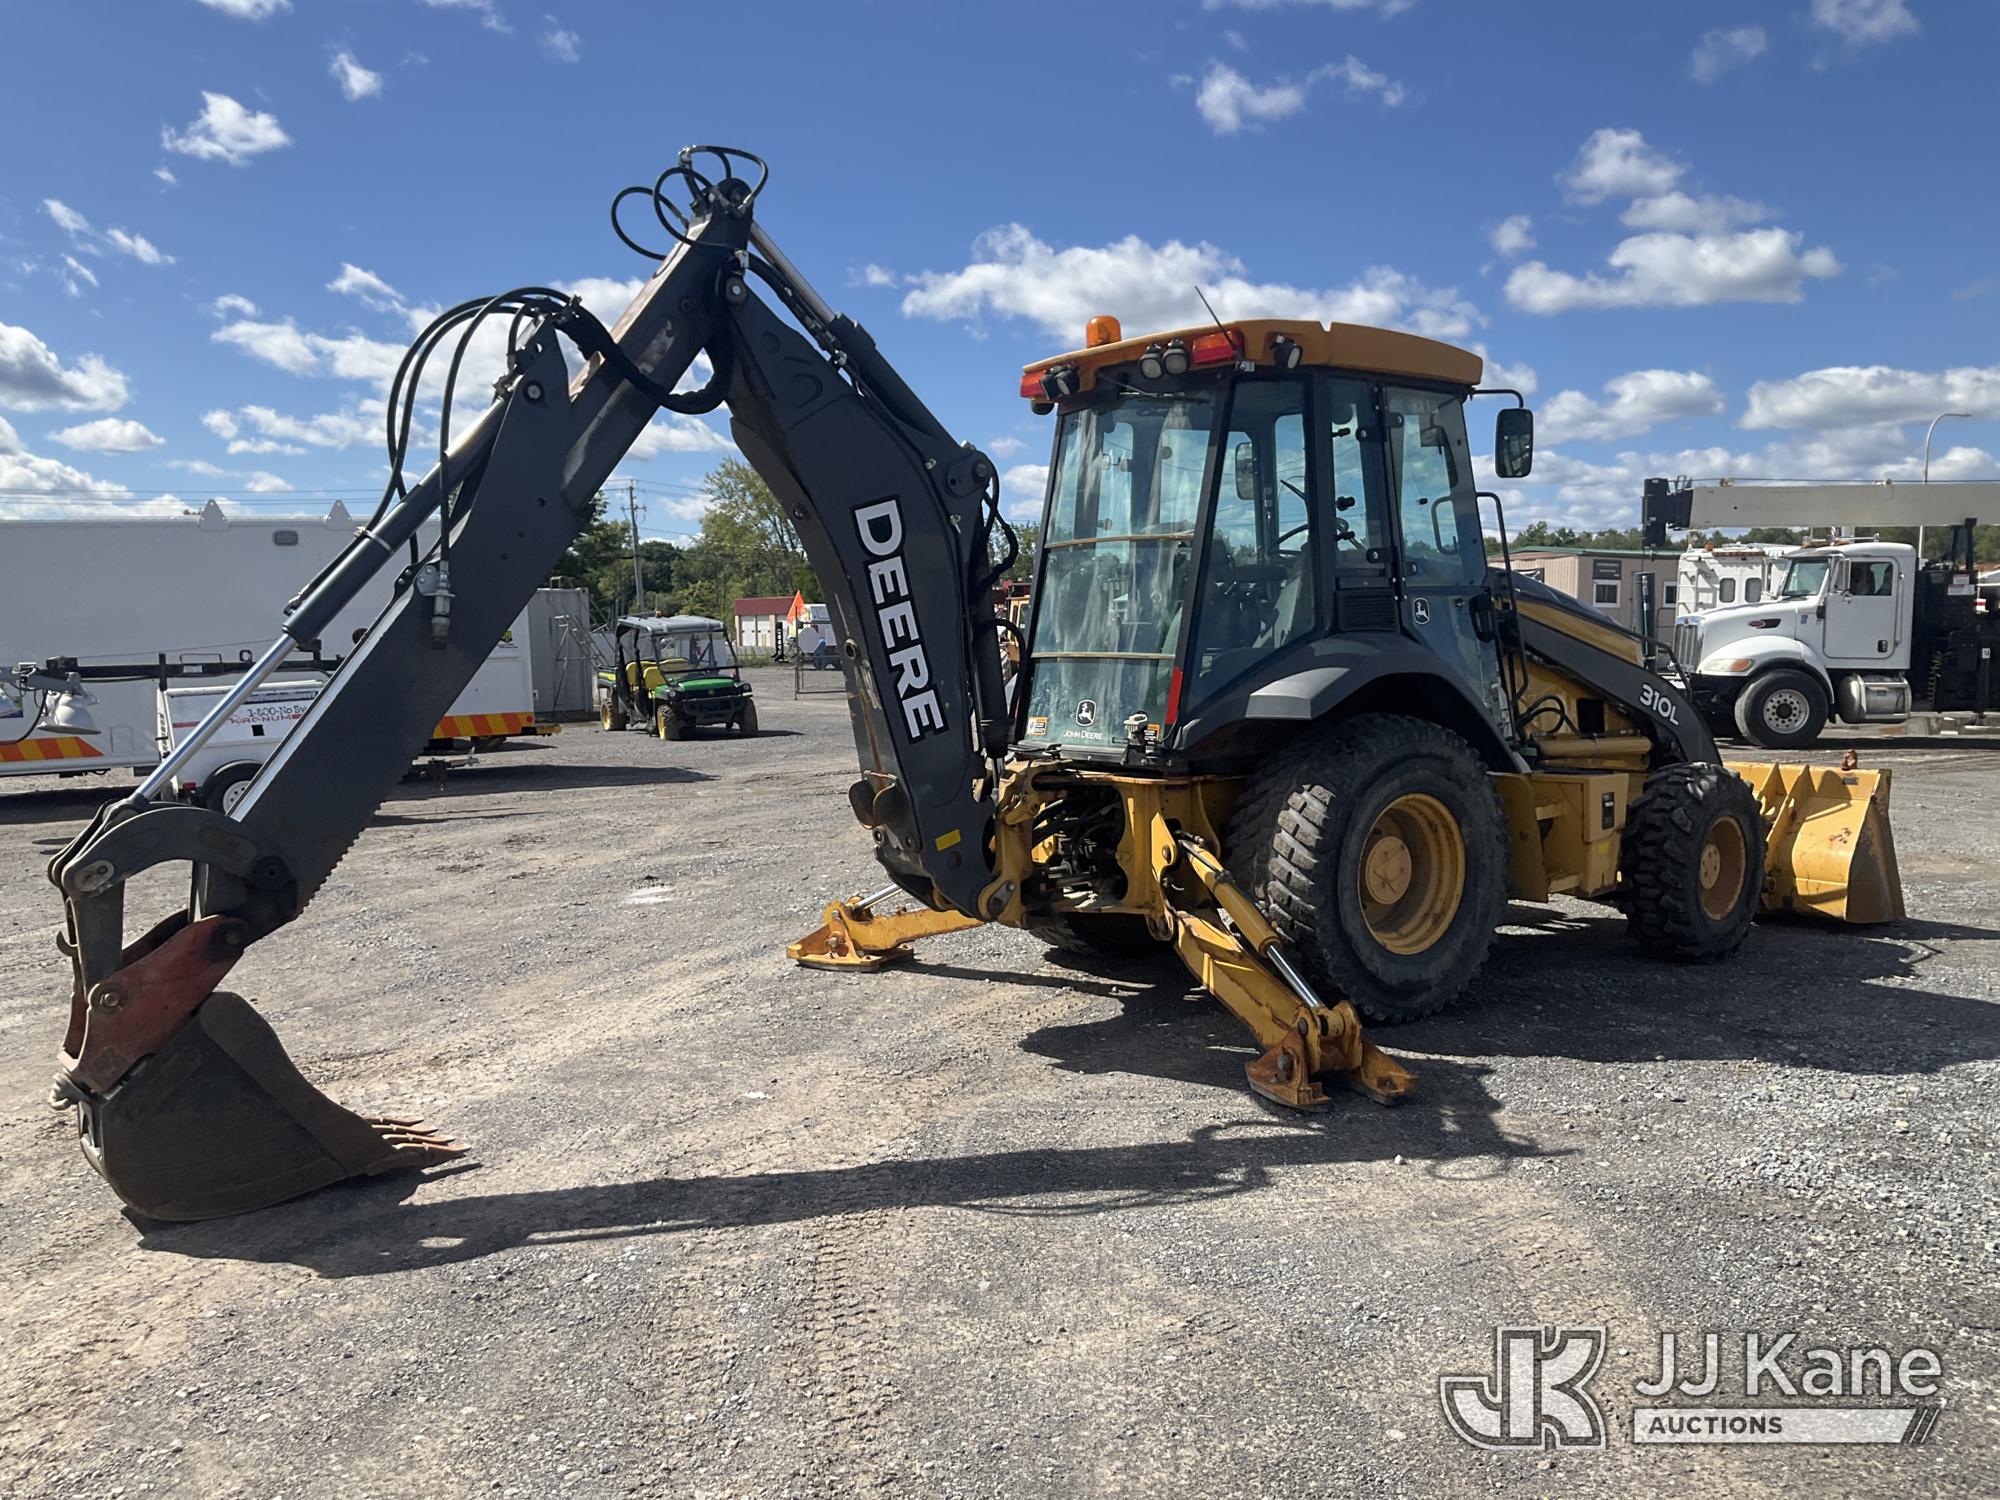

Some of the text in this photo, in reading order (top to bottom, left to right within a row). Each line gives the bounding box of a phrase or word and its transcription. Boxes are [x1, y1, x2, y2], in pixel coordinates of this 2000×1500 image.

[854, 499, 945, 739] DEERE
[1639, 683, 1679, 726] 310L
[1064, 730, 1104, 740] JOHN DEERE
